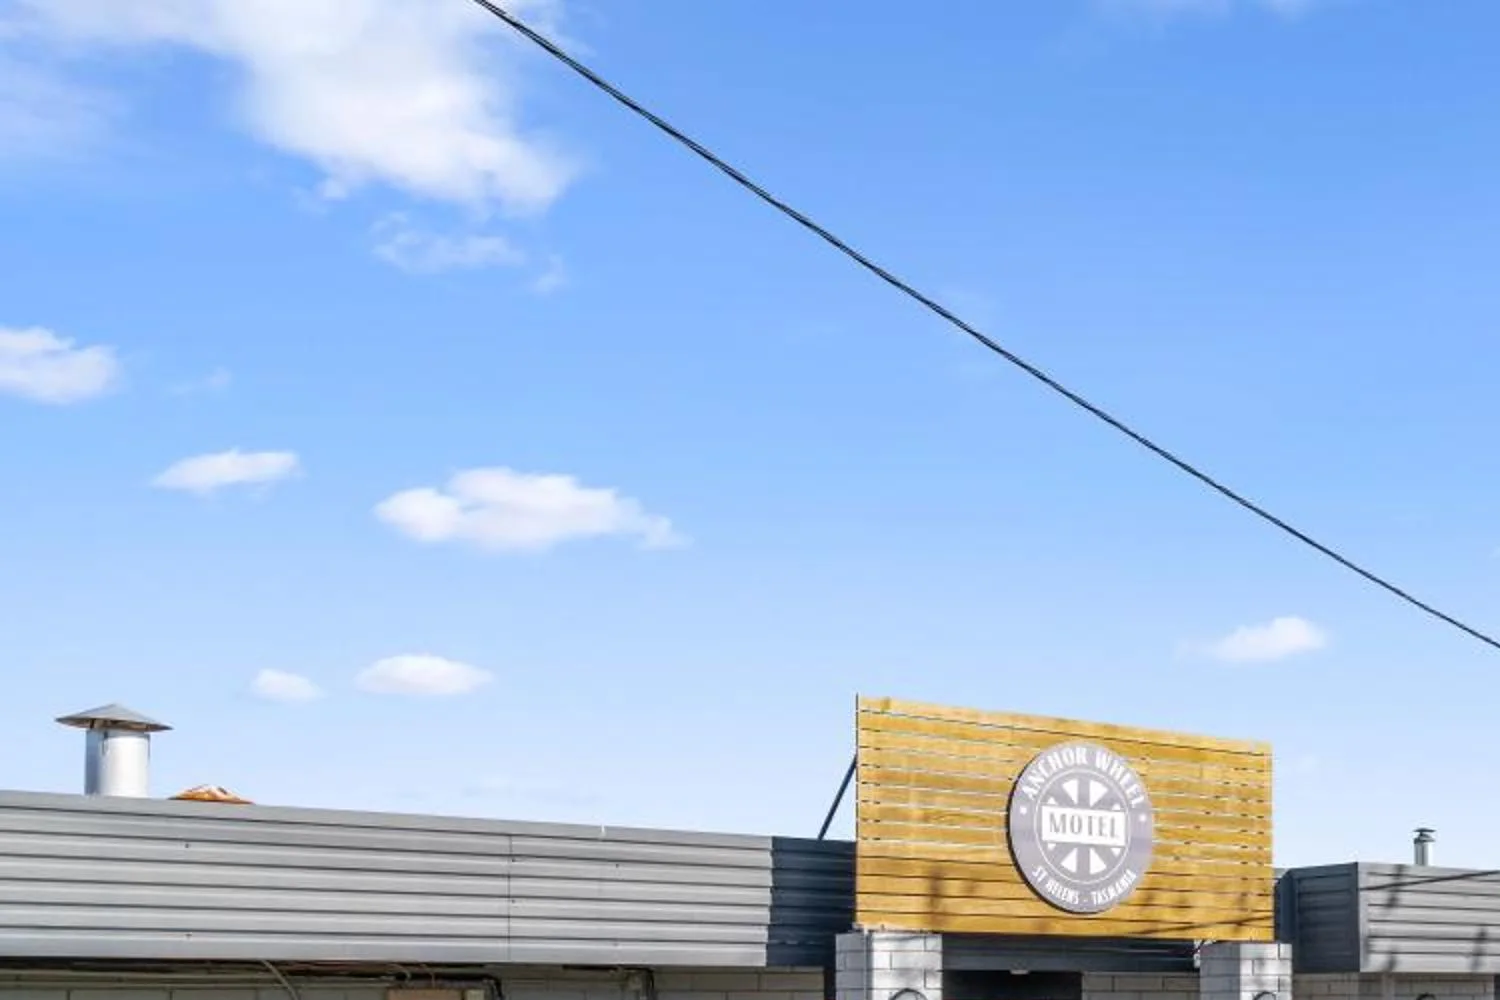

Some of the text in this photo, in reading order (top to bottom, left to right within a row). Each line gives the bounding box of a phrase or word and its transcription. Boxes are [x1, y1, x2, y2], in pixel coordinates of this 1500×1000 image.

[1021, 747, 1145, 809] ANCHOR WHEEL
[1049, 813, 1120, 839] MOTEL
